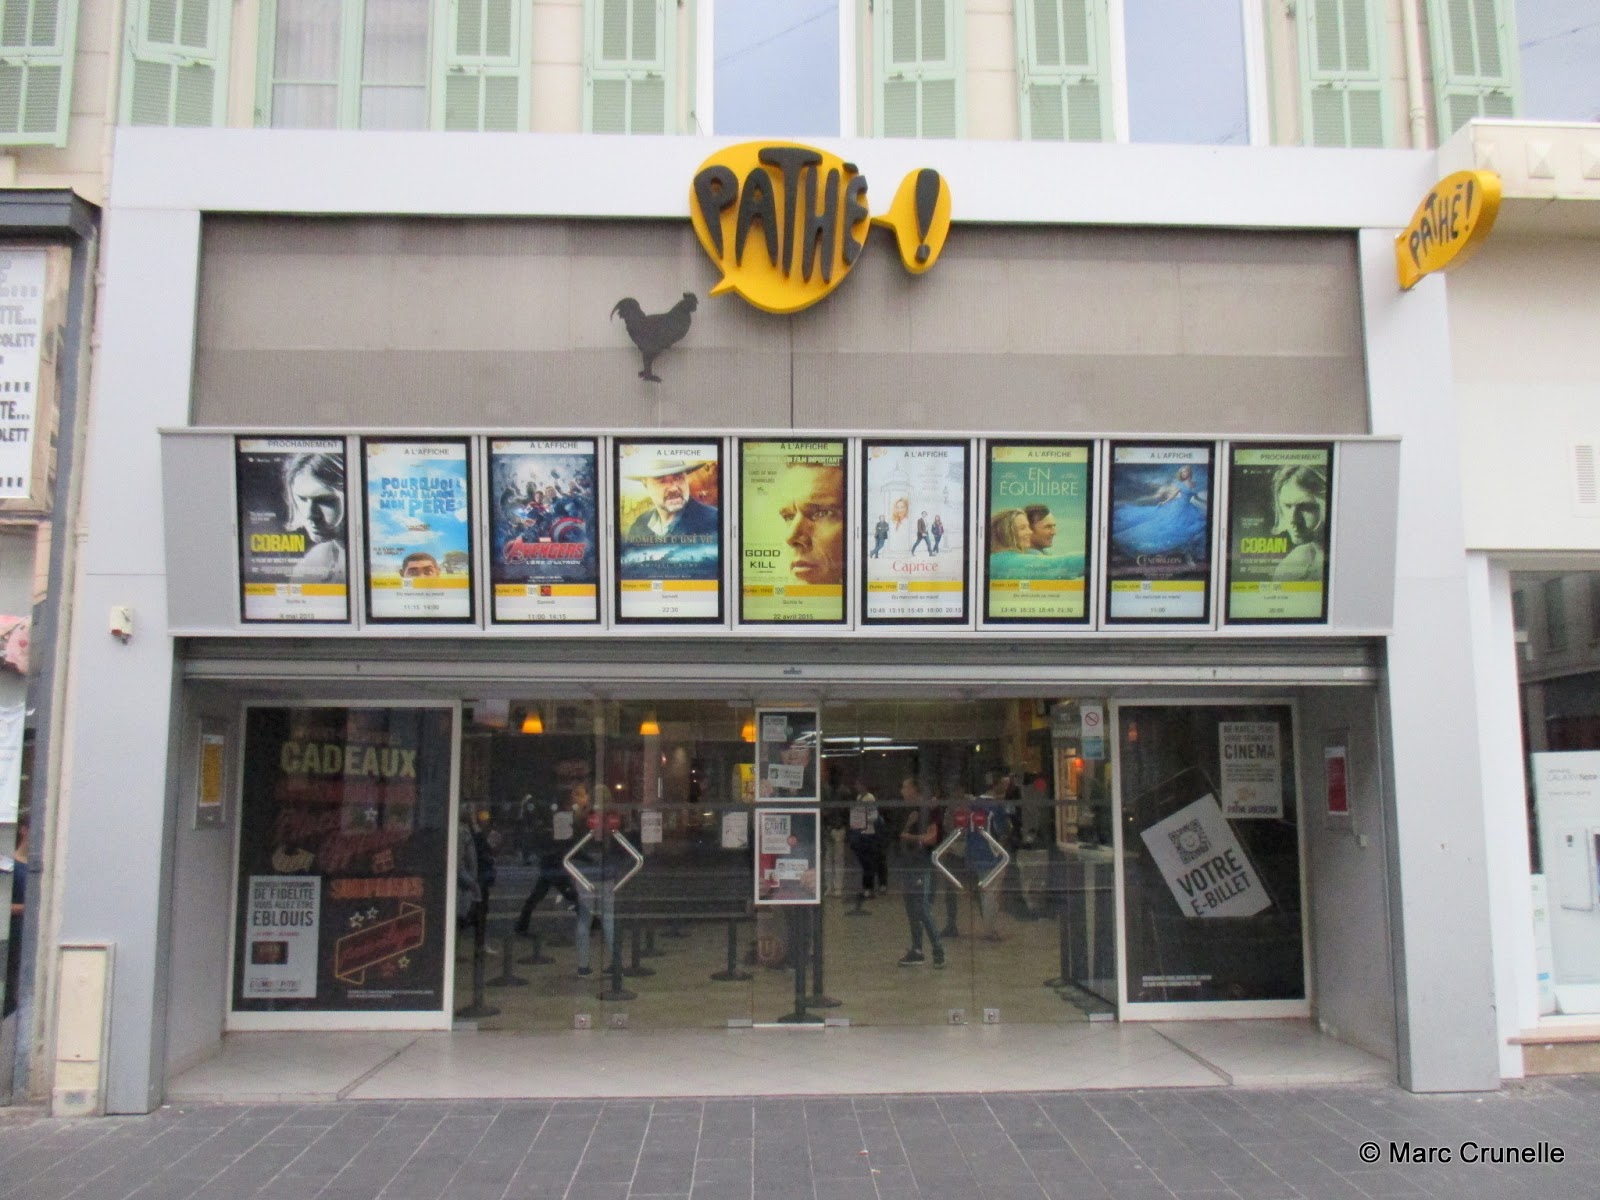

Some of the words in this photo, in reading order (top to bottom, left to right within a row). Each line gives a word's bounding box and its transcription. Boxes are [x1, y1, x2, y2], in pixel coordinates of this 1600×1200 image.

[915, 168, 941, 264] !
[267, 440, 339, 448] PROCHAINEMENT
[1028, 467, 1051, 481] EN
[381, 477, 453, 491] POURQUOI
[250, 534, 305, 552] COBAIN
[1241, 537, 1287, 553] COBAIN
[745, 549, 781, 557] GOOD
[750, 561, 776, 569] KILL
[892, 560, 939, 574] Caprice
[280, 740, 417, 778] CADEAUX
[1176, 846, 1242, 897] VOTRE
[1190, 872, 1252, 916] E-BILLET
[253, 910, 314, 926] EBLOUIS
